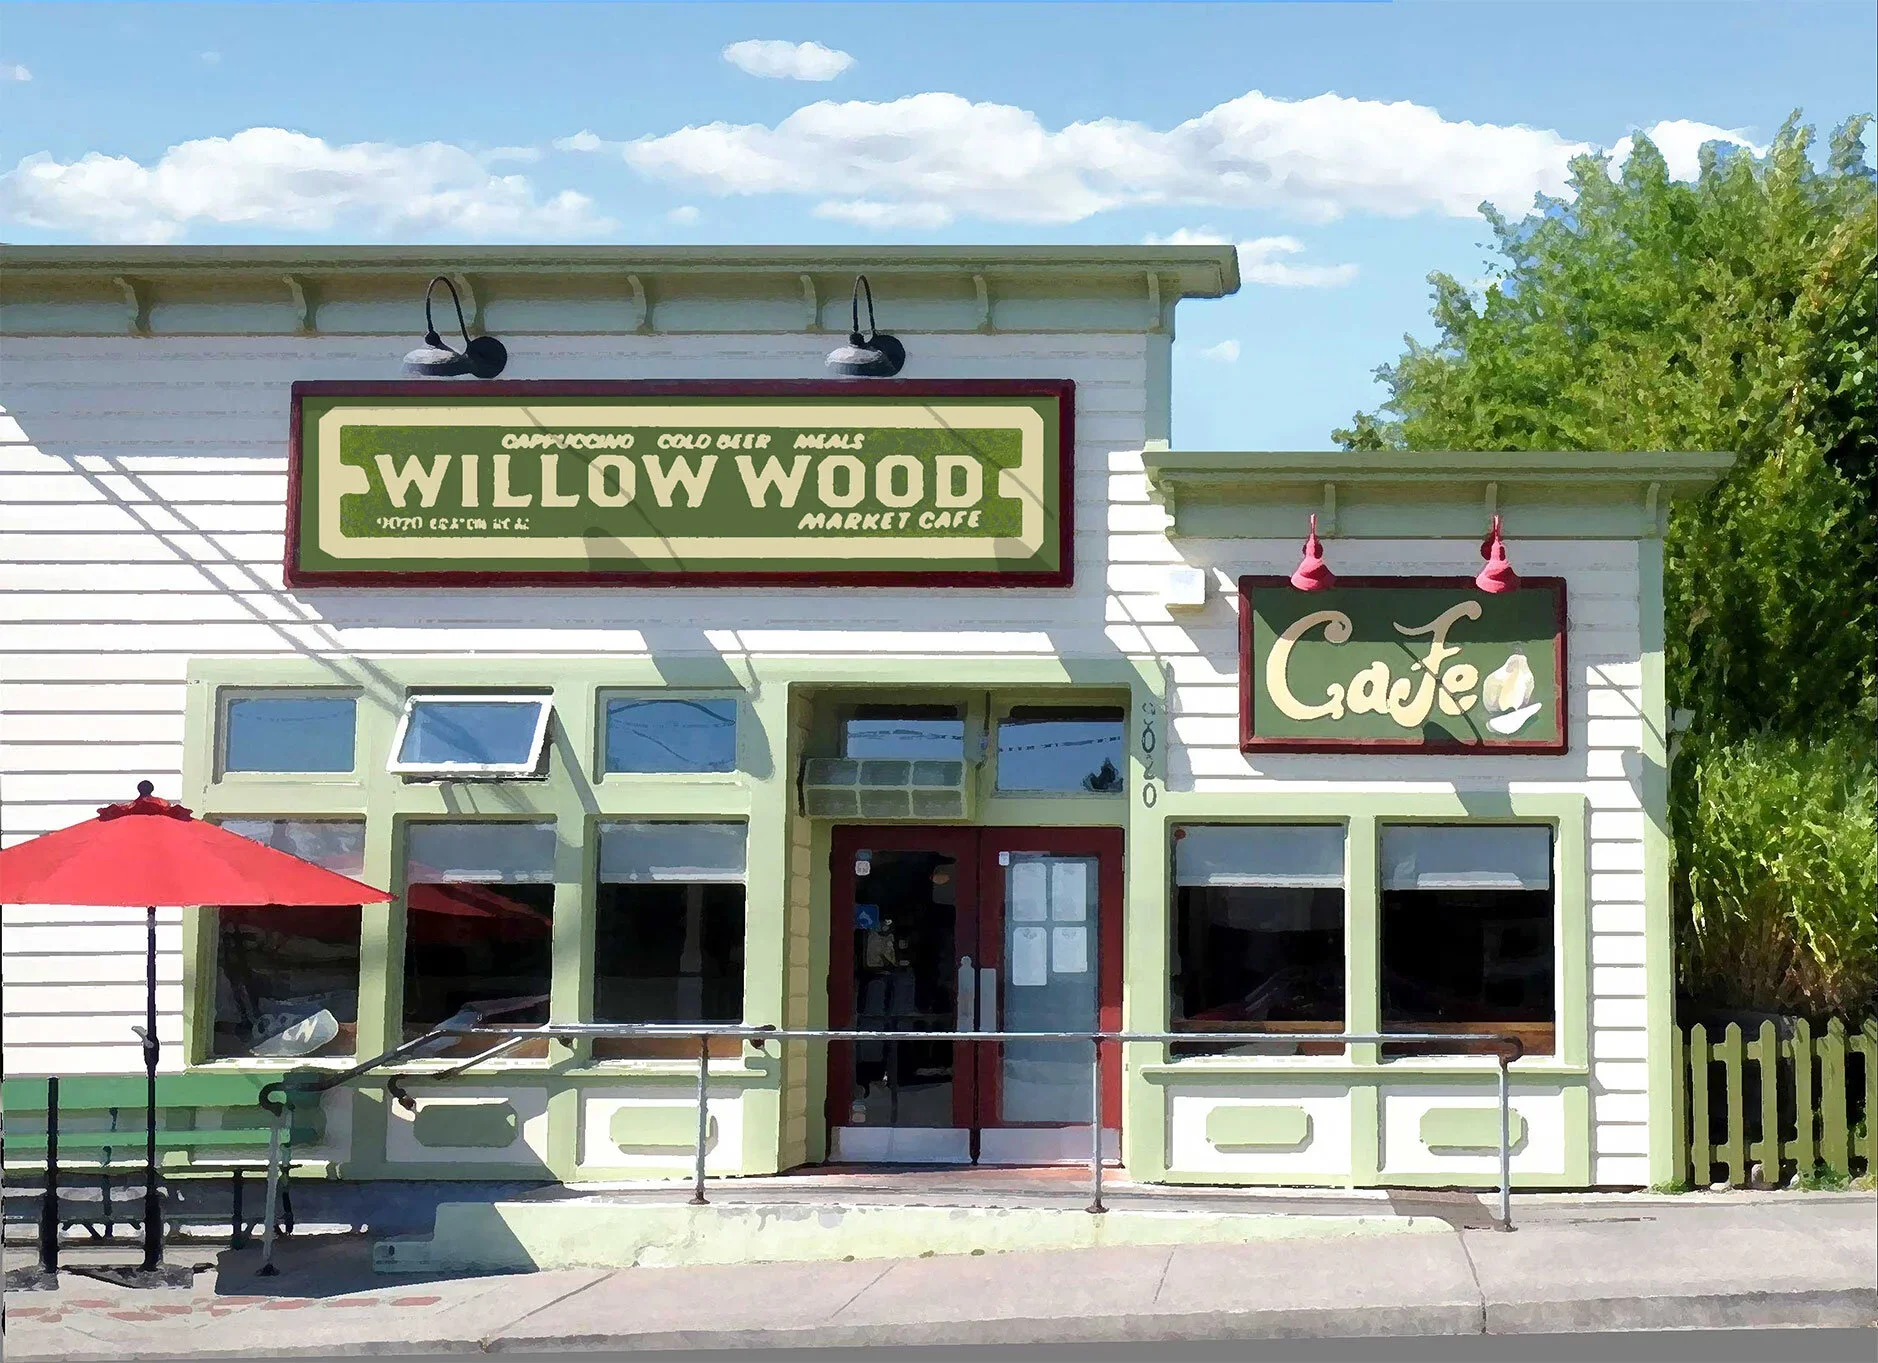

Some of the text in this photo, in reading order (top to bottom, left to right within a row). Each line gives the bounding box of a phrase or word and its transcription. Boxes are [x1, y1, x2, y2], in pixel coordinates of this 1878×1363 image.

[502, 433, 866, 450] CAPPUCCINO COLD BEER MEALS
[374, 454, 983, 508] WILLOW WOOD
[798, 511, 982, 530] MARKET CAFE
